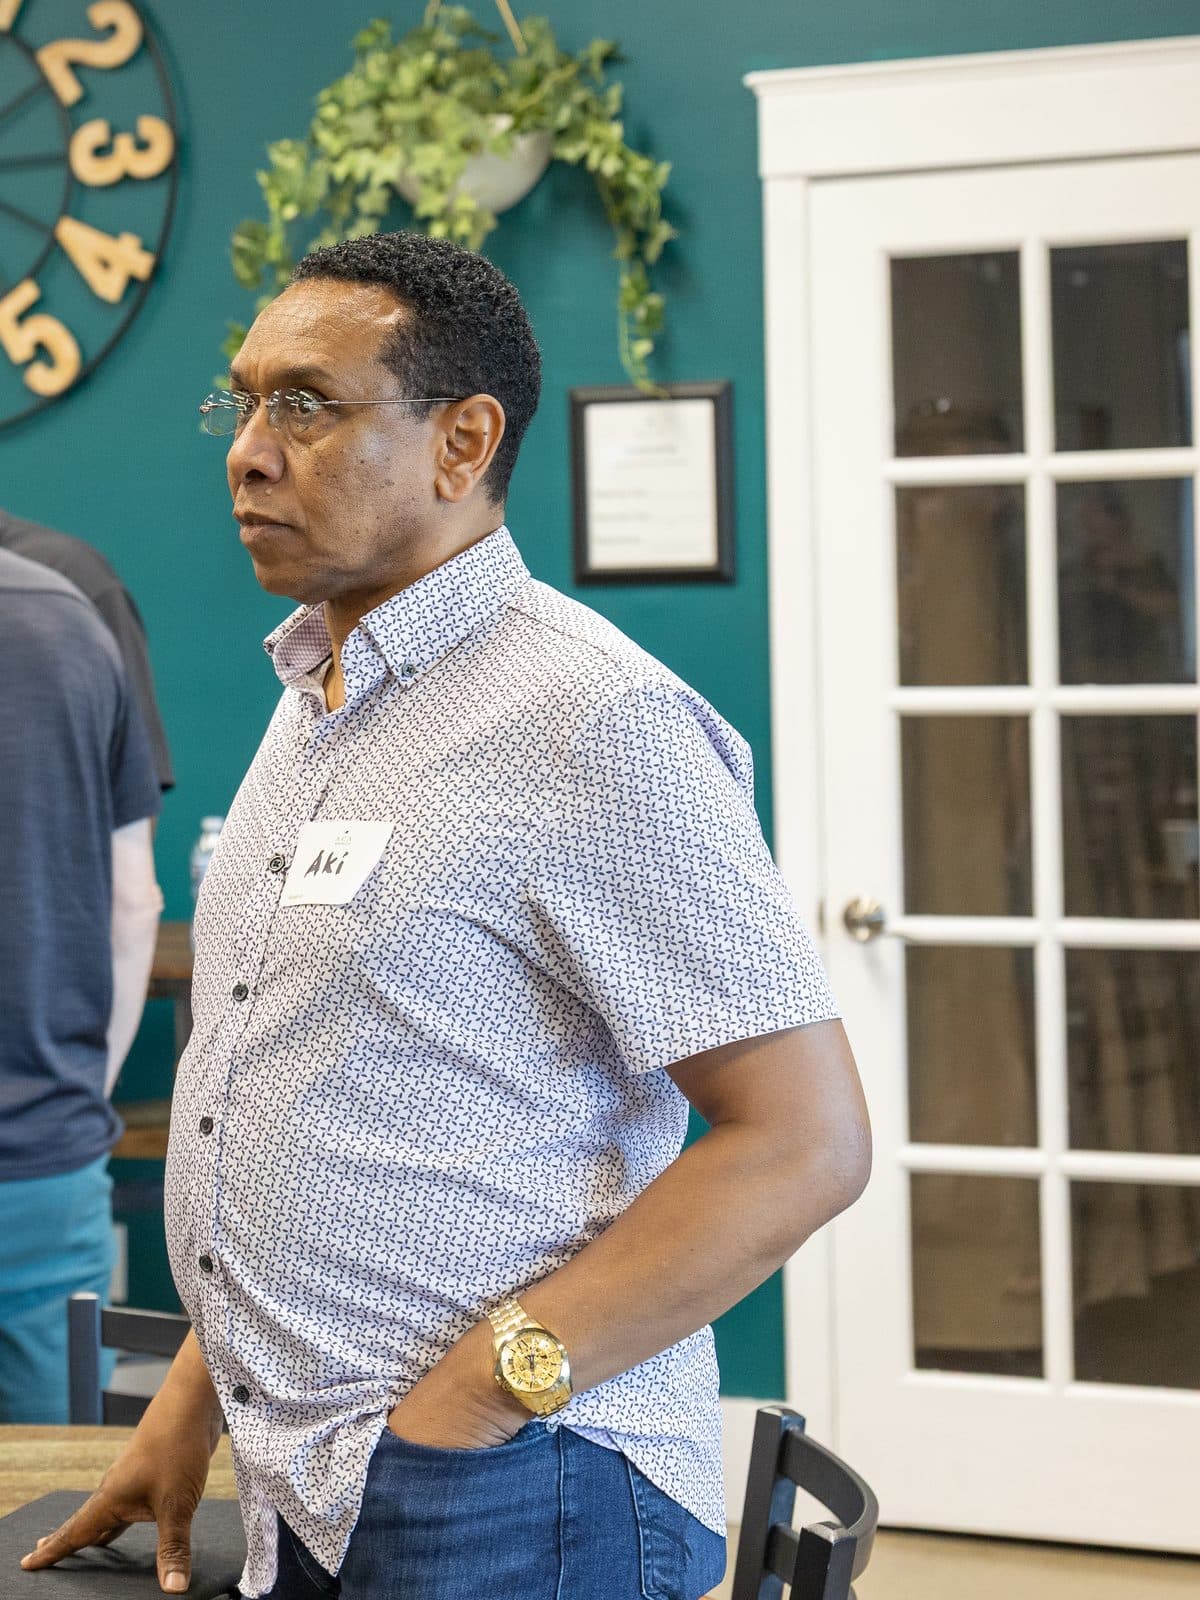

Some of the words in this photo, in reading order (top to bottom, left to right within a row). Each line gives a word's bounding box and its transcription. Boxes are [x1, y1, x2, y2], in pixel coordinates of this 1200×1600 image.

[36, 0, 142, 106] 2
[69, 115, 174, 186] 3
[55, 215, 155, 303] 4
